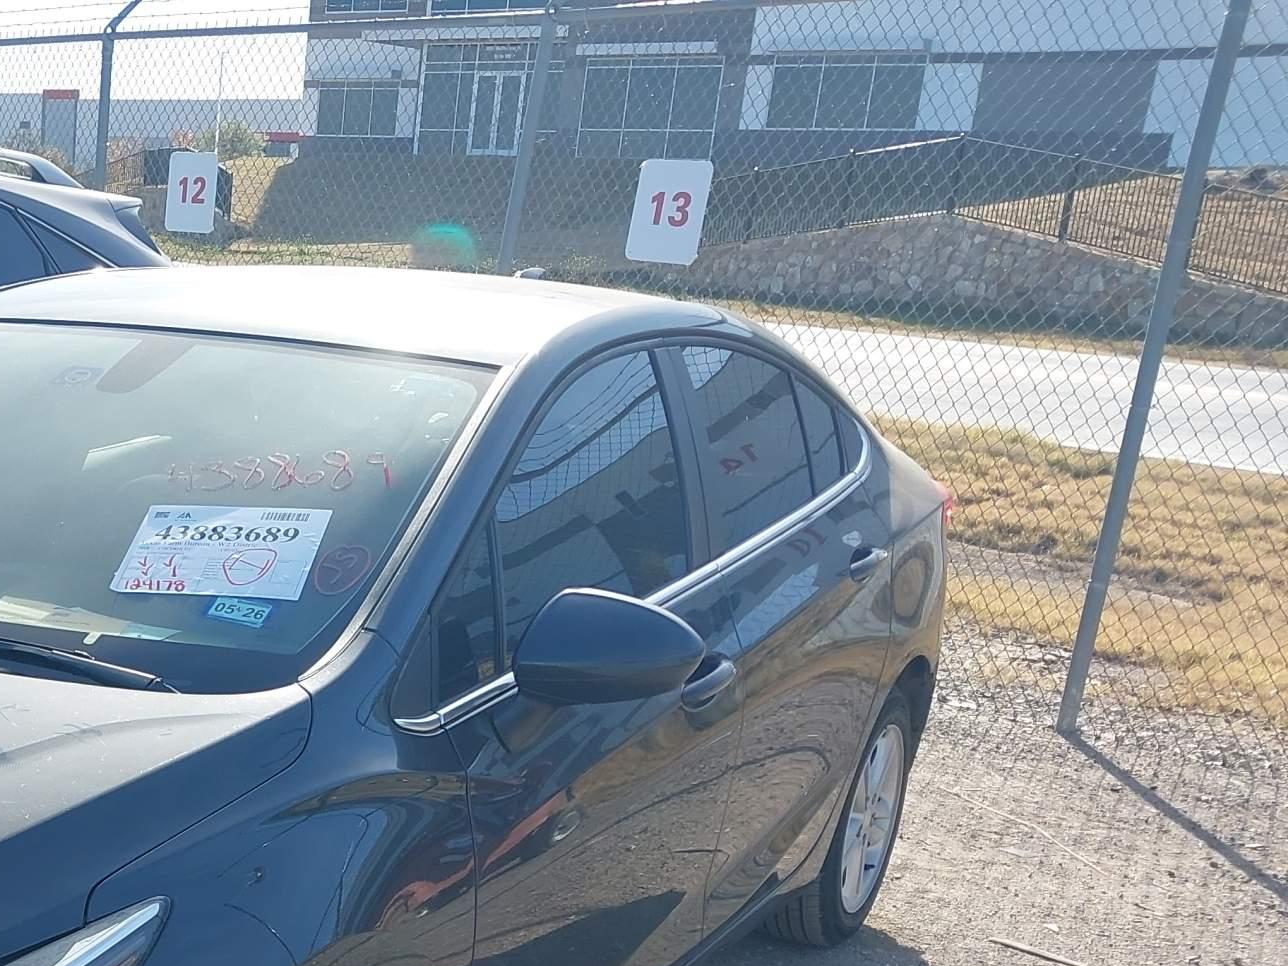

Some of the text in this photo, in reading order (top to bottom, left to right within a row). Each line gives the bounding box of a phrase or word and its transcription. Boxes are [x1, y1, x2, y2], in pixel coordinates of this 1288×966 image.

[178, 176, 206, 204] 12
[650, 191, 693, 228] 13
[155, 525, 300, 542] 43883689
